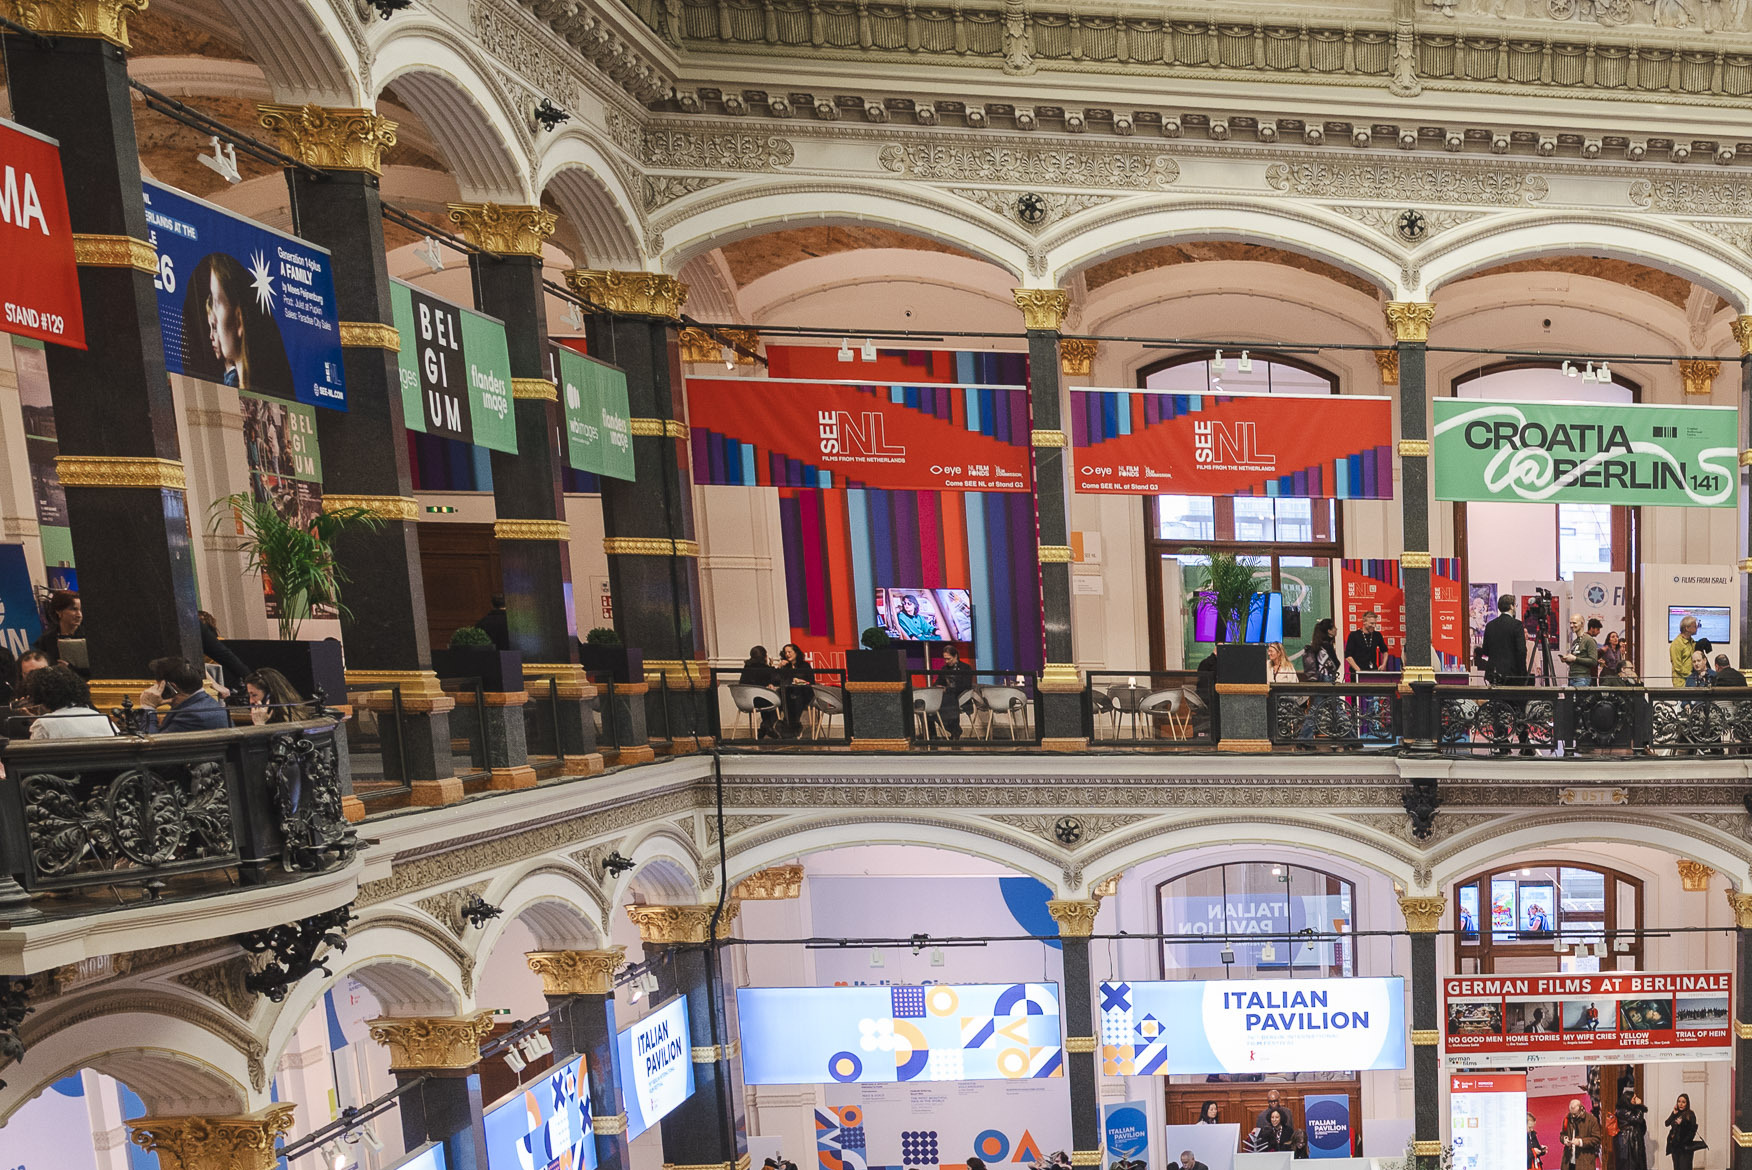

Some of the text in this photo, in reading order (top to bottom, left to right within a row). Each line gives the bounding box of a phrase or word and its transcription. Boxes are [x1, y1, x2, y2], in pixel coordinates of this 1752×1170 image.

[184, 222, 196, 239] THE
[277, 247, 305, 266] Generation
[287, 265, 312, 285] FAMILY
[5, 303, 64, 334] STAND #129
[419, 303, 458, 351] BEL
[425, 348, 447, 388] GI
[471, 364, 506, 395] flanders
[428, 390, 461, 433] UM
[482, 392, 508, 419] image
[569, 418, 599, 442] wbimages
[602, 408, 627, 433] flanders
[819, 410, 906, 456] SEE NL
[1195, 420, 1275, 464] SEE NL
[1464, 421, 1634, 454] CROATIA
[944, 465, 961, 477] eye
[1095, 465, 1112, 477] eye
[1690, 476, 1719, 491] 141
[1681, 575, 1727, 585] FILMS FROM ISRAEL
[1447, 976, 1728, 995] GERMAN FILMS AT BERLINALE
[1223, 991, 1328, 1010] ITALIAN
[1246, 1011, 1369, 1031] PAVILION
[637, 1019, 670, 1057] ITALIAN
[646, 1037, 682, 1078] PAVILION
[1448, 1056, 1470, 1064] german
[1108, 1127, 1135, 1135] ITALIAN
[1308, 1119, 1336, 1127] ITALIAN
[1314, 1124, 1347, 1132] PAVILION
[1114, 1130, 1146, 1140] PAVILION
